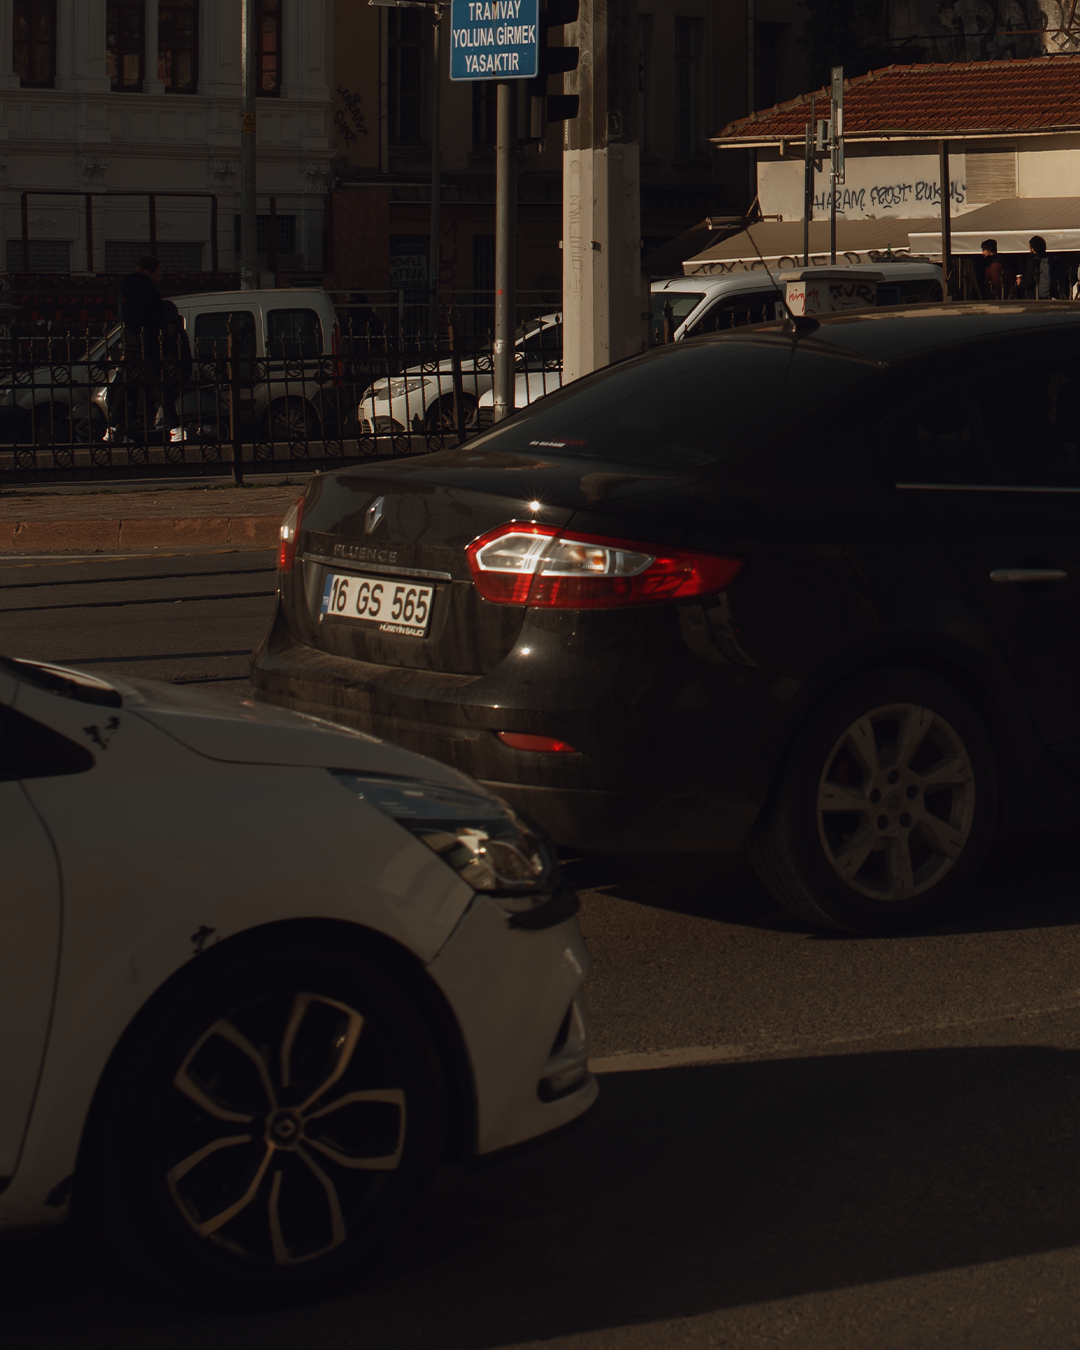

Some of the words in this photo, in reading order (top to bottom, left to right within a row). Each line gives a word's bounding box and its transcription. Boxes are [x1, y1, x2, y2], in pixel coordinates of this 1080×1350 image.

[468, 0, 521, 21] TRAMVAY
[453, 27, 495, 48] YOLUNA
[496, 22, 536, 45] GİRMEK
[465, 52, 519, 73] YASAKTIR
[645, 196, 695, 209] RMANN
[333, 543, 398, 563] FLUENCE
[331, 577, 349, 612] 16
[356, 582, 384, 617] GS
[391, 586, 430, 624] 565
